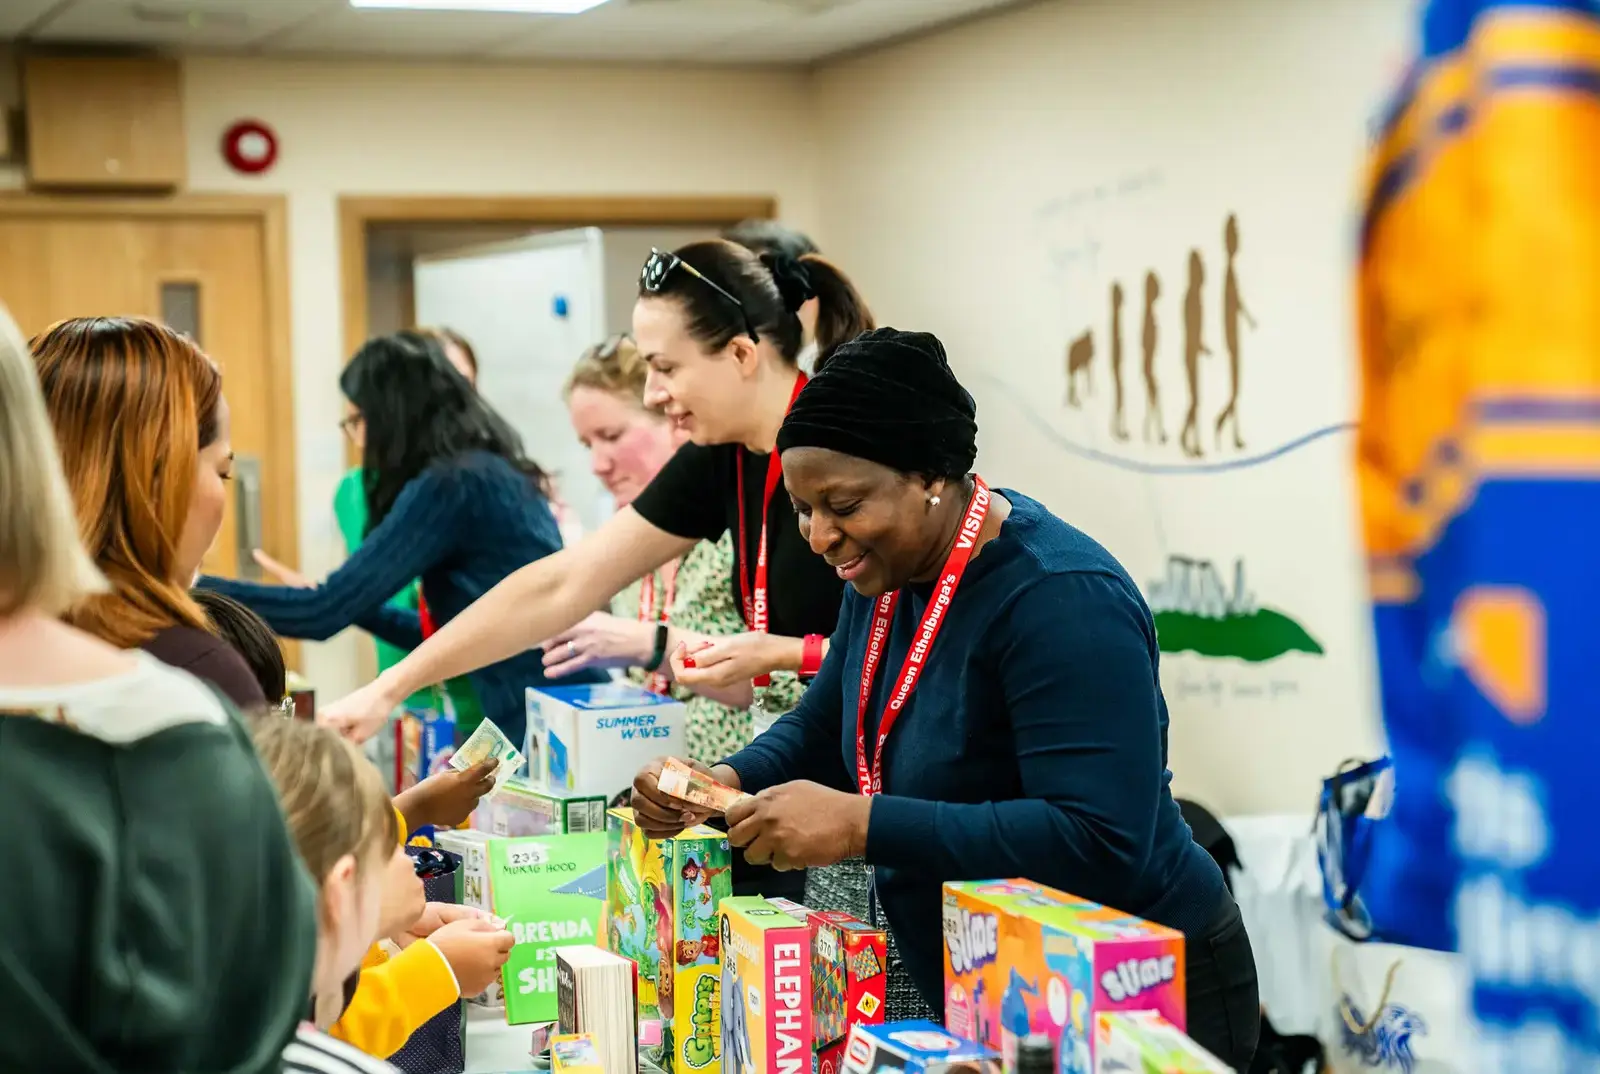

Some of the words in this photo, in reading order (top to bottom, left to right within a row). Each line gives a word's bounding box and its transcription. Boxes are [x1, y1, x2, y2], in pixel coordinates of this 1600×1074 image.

[956, 485, 990, 548] VISITOR
[753, 588, 767, 634] ITOR
[890, 666, 918, 711] Queen
[910, 573, 957, 664] Ethelburga's
[596, 714, 657, 729] SUMMER
[621, 726, 671, 740] WAVES
[857, 734, 872, 798] VISITO
[511, 850, 541, 864] 235
[546, 861, 577, 874] HOOD
[512, 917, 594, 945] BRENDA
[535, 946, 557, 962] IS
[819, 938, 832, 957] 370
